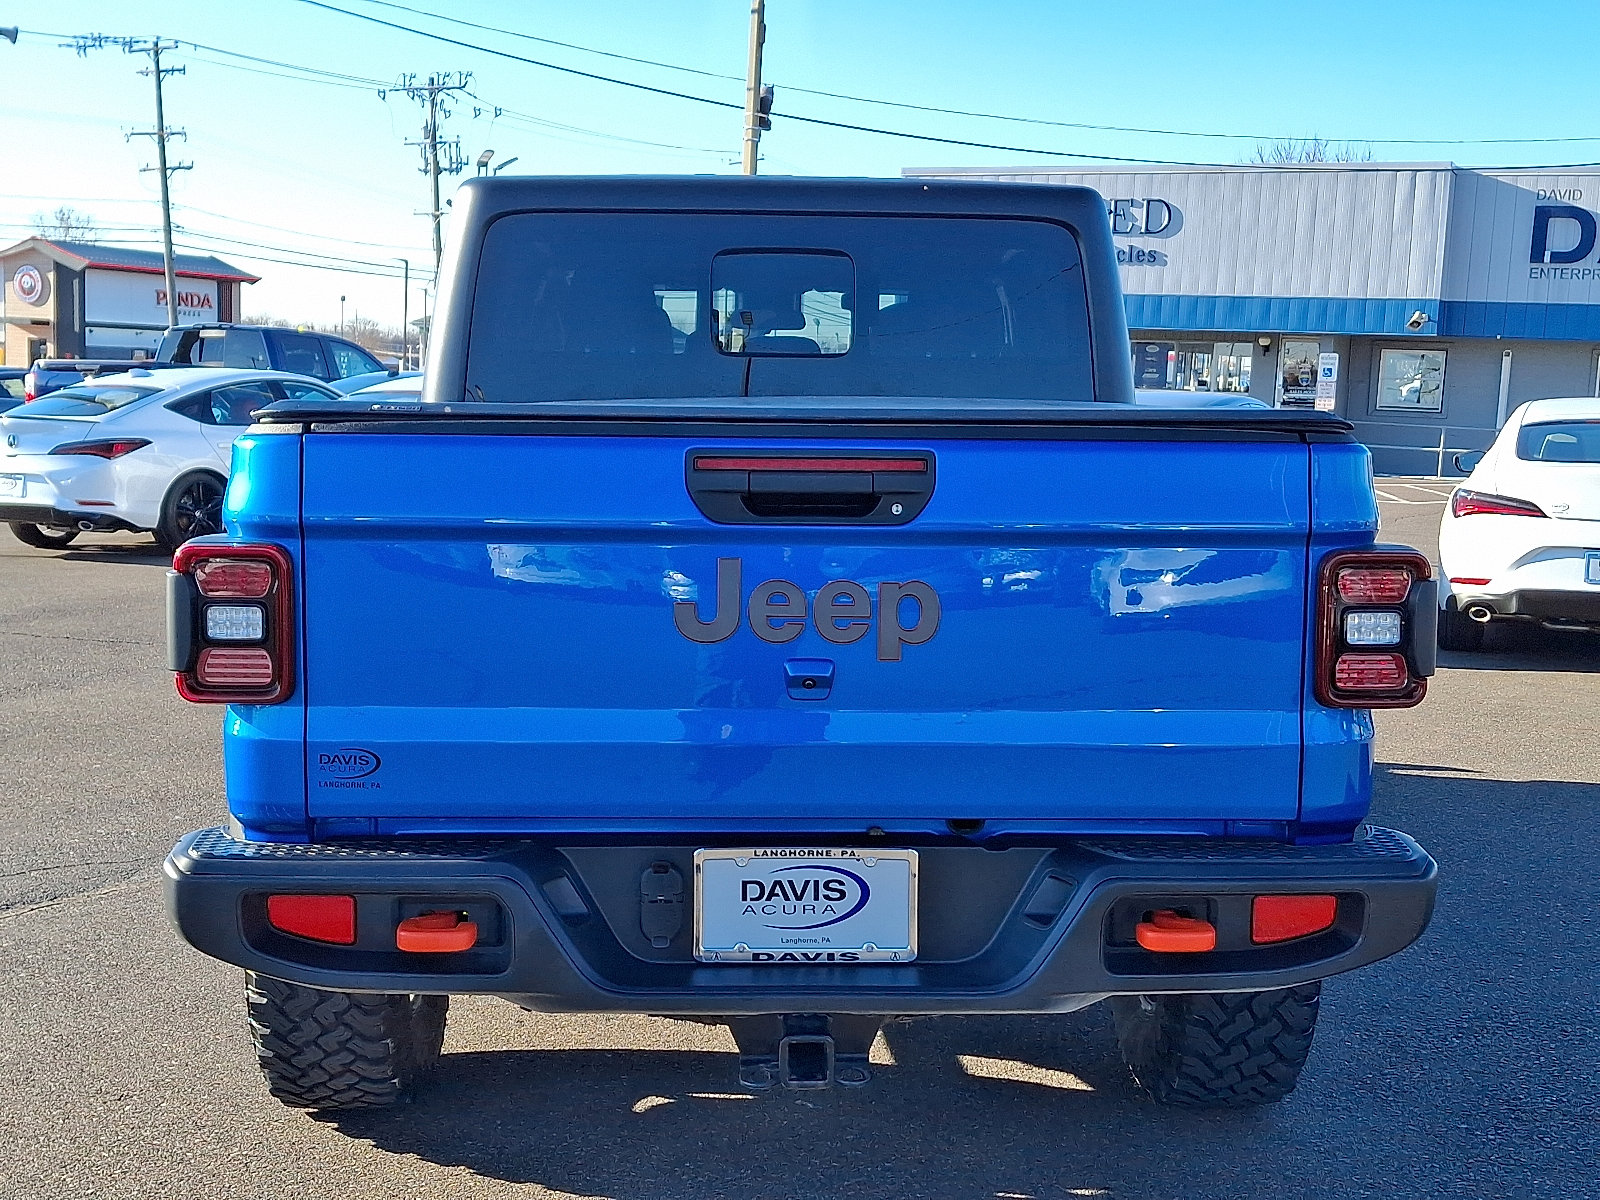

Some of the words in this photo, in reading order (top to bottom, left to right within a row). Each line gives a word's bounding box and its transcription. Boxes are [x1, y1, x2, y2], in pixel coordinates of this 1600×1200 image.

[1536, 188, 1583, 202] DAVID
[1530, 205, 1600, 264] D
[155, 289, 213, 309] PNDA
[673, 557, 941, 662] Jeep
[319, 753, 370, 766] DAVIS
[319, 764, 366, 773] ACURA
[741, 879, 846, 902] DAVIS
[741, 904, 837, 916] ACURA
[780, 936, 822, 945] Langhorne,
[822, 936, 831, 944] PA
[751, 952, 860, 962] DAVIS
